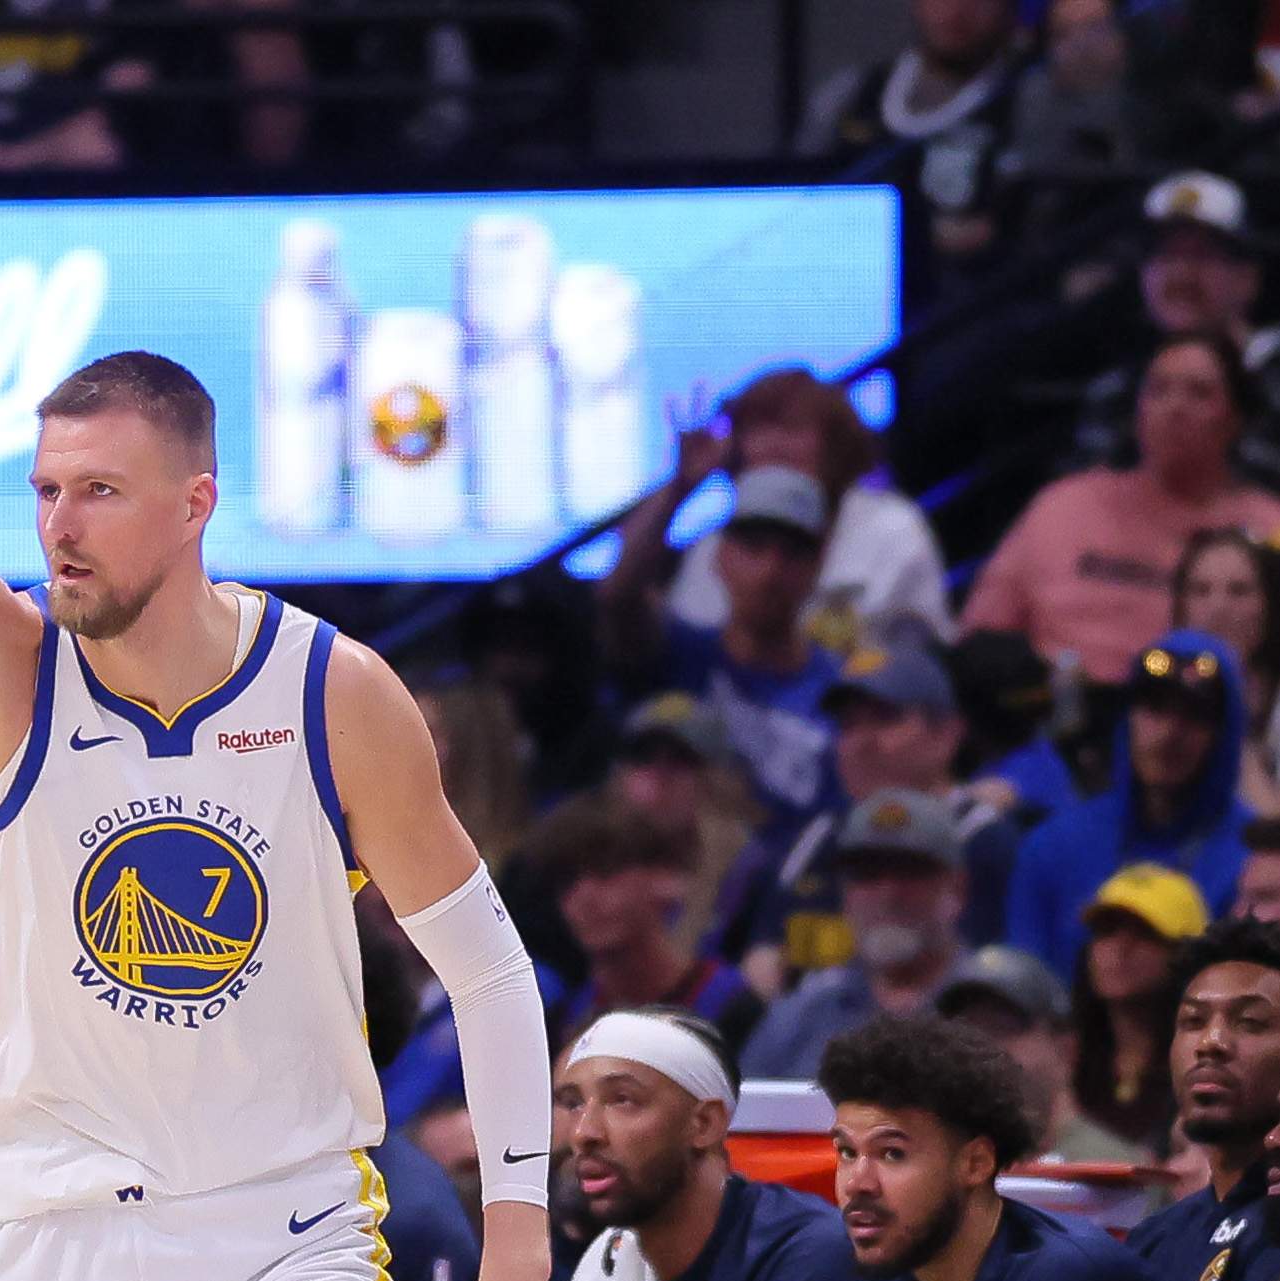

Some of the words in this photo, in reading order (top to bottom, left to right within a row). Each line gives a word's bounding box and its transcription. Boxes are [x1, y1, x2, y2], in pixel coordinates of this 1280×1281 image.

[217, 728, 296, 751] Rakuten
[78, 795, 183, 850] GOLDEN
[196, 799, 272, 860] STATE
[200, 867, 232, 919] 7
[70, 954, 264, 1030] WARRIORS
